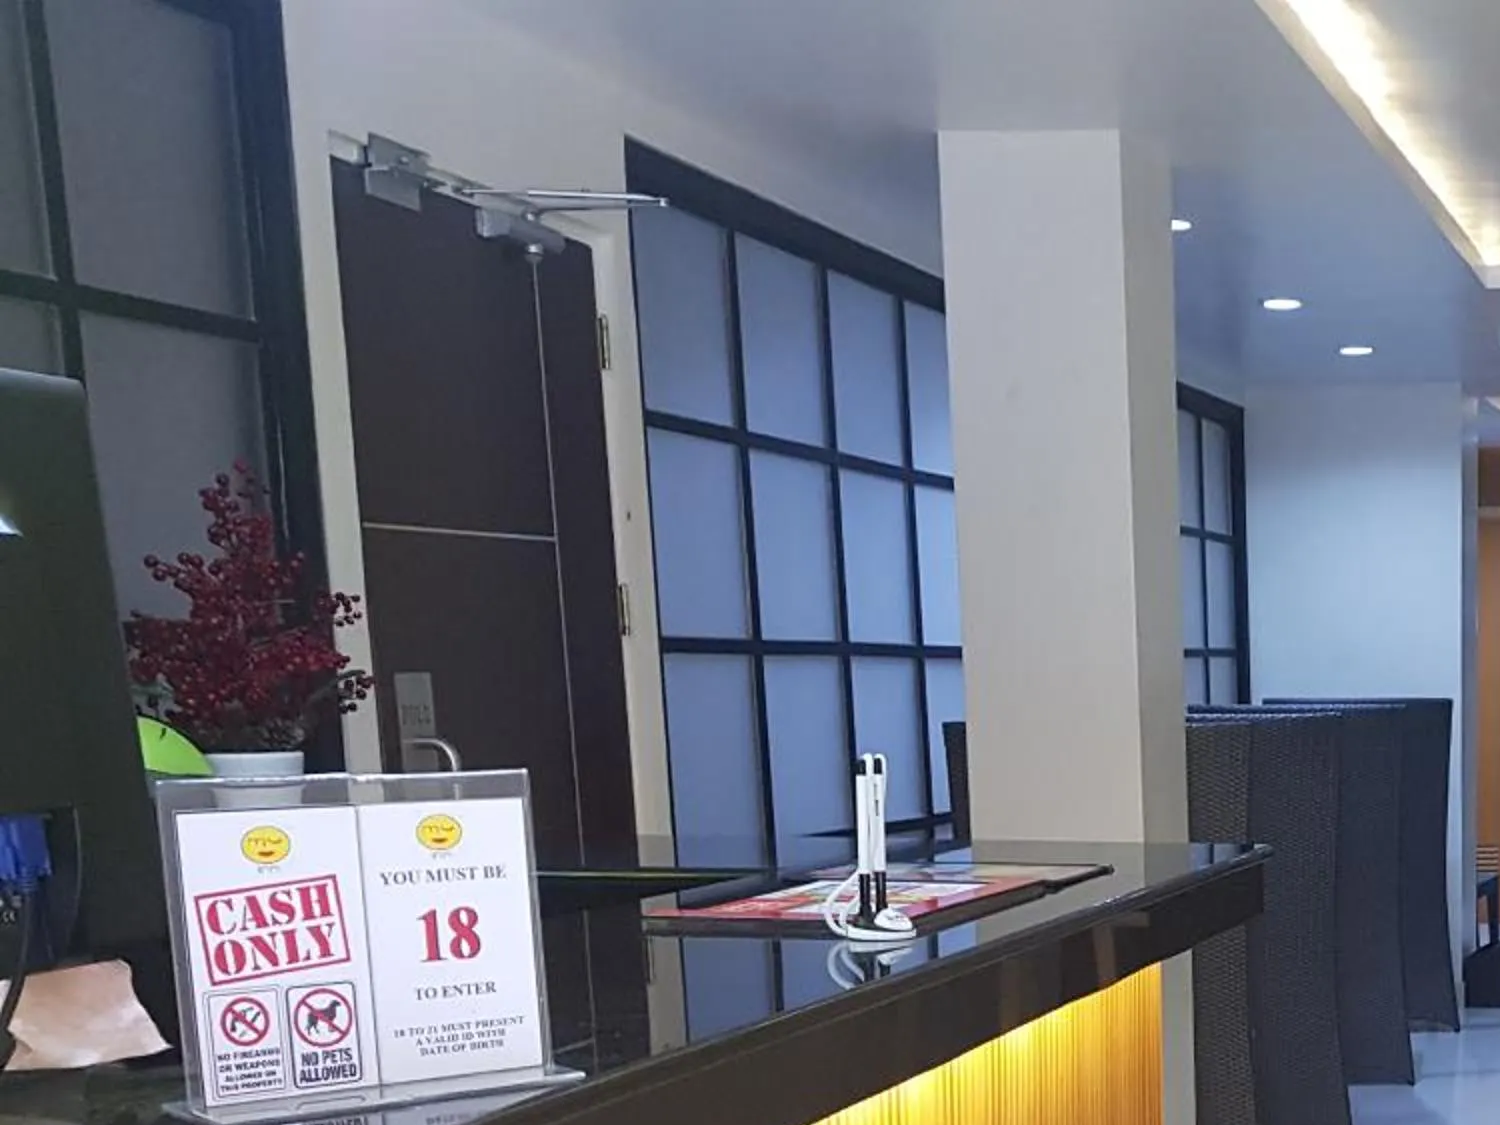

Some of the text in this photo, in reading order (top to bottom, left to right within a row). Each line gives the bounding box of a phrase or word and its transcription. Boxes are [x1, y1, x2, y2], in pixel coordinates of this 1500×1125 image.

[379, 864, 507, 886] YOU MUST BE
[206, 883, 334, 935] CASH
[416, 906, 481, 962] 18
[213, 922, 336, 976] ONLY
[415, 980, 497, 1001] TO ENTER
[408, 1026, 425, 1038] TO
[441, 1020, 472, 1033] MUST
[475, 1015, 525, 1030] PRESENT
[217, 1051, 231, 1061] NO
[301, 1047, 353, 1067] NO PETS
[420, 1045, 449, 1057] DATE
[219, 1058, 281, 1073] OR WEAPONS
[300, 1063, 357, 1083] ALLOWED
